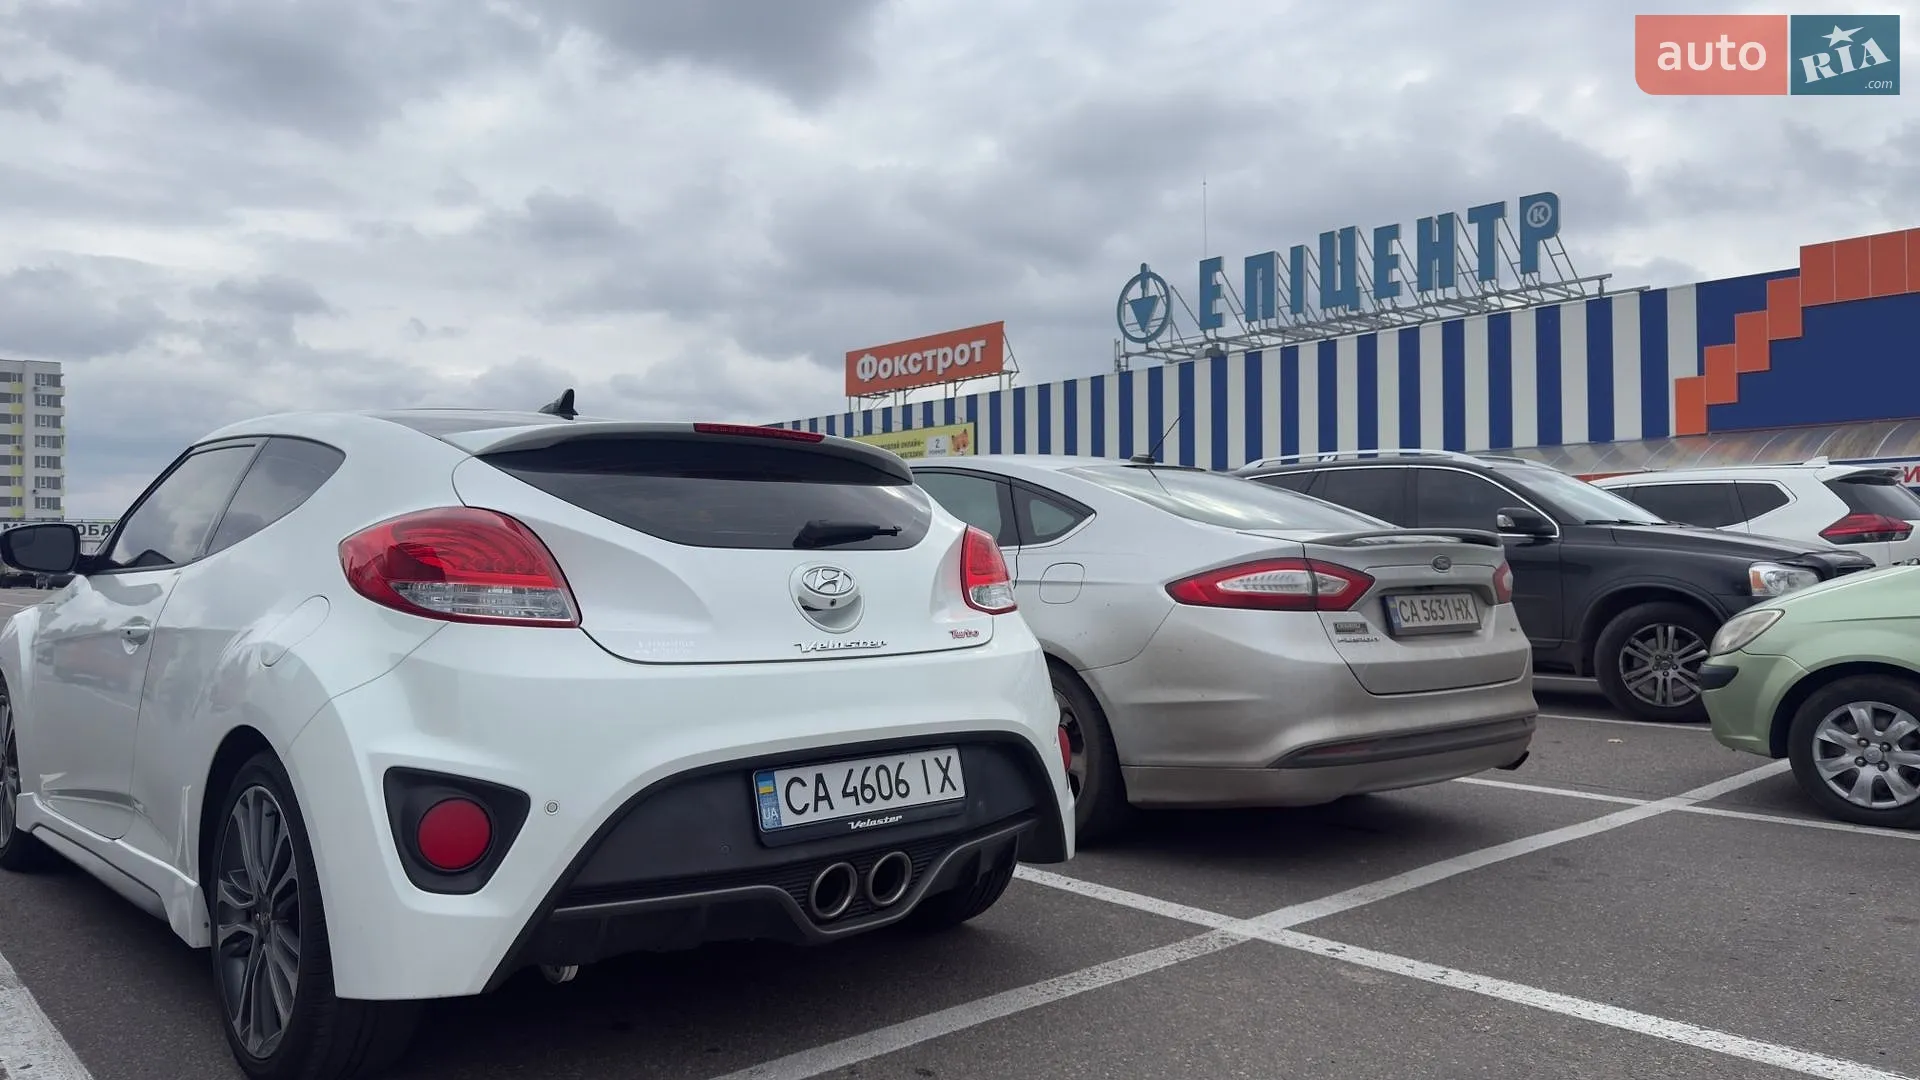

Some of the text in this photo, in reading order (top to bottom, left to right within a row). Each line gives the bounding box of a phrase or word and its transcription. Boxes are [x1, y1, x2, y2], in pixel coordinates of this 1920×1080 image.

[1199, 192, 1561, 331] ЕПІЦЕНТР
[856, 340, 986, 382] Фокстрот
[934, 438, 941, 449] 2
[1399, 598, 1474, 622] CA 5631 HX
[949, 629, 979, 639] Turbo
[794, 640, 887, 653] Veloster
[785, 756, 957, 815] CA 4606 IX
[763, 809, 779, 821] UA
[848, 815, 902, 830] Veloster
